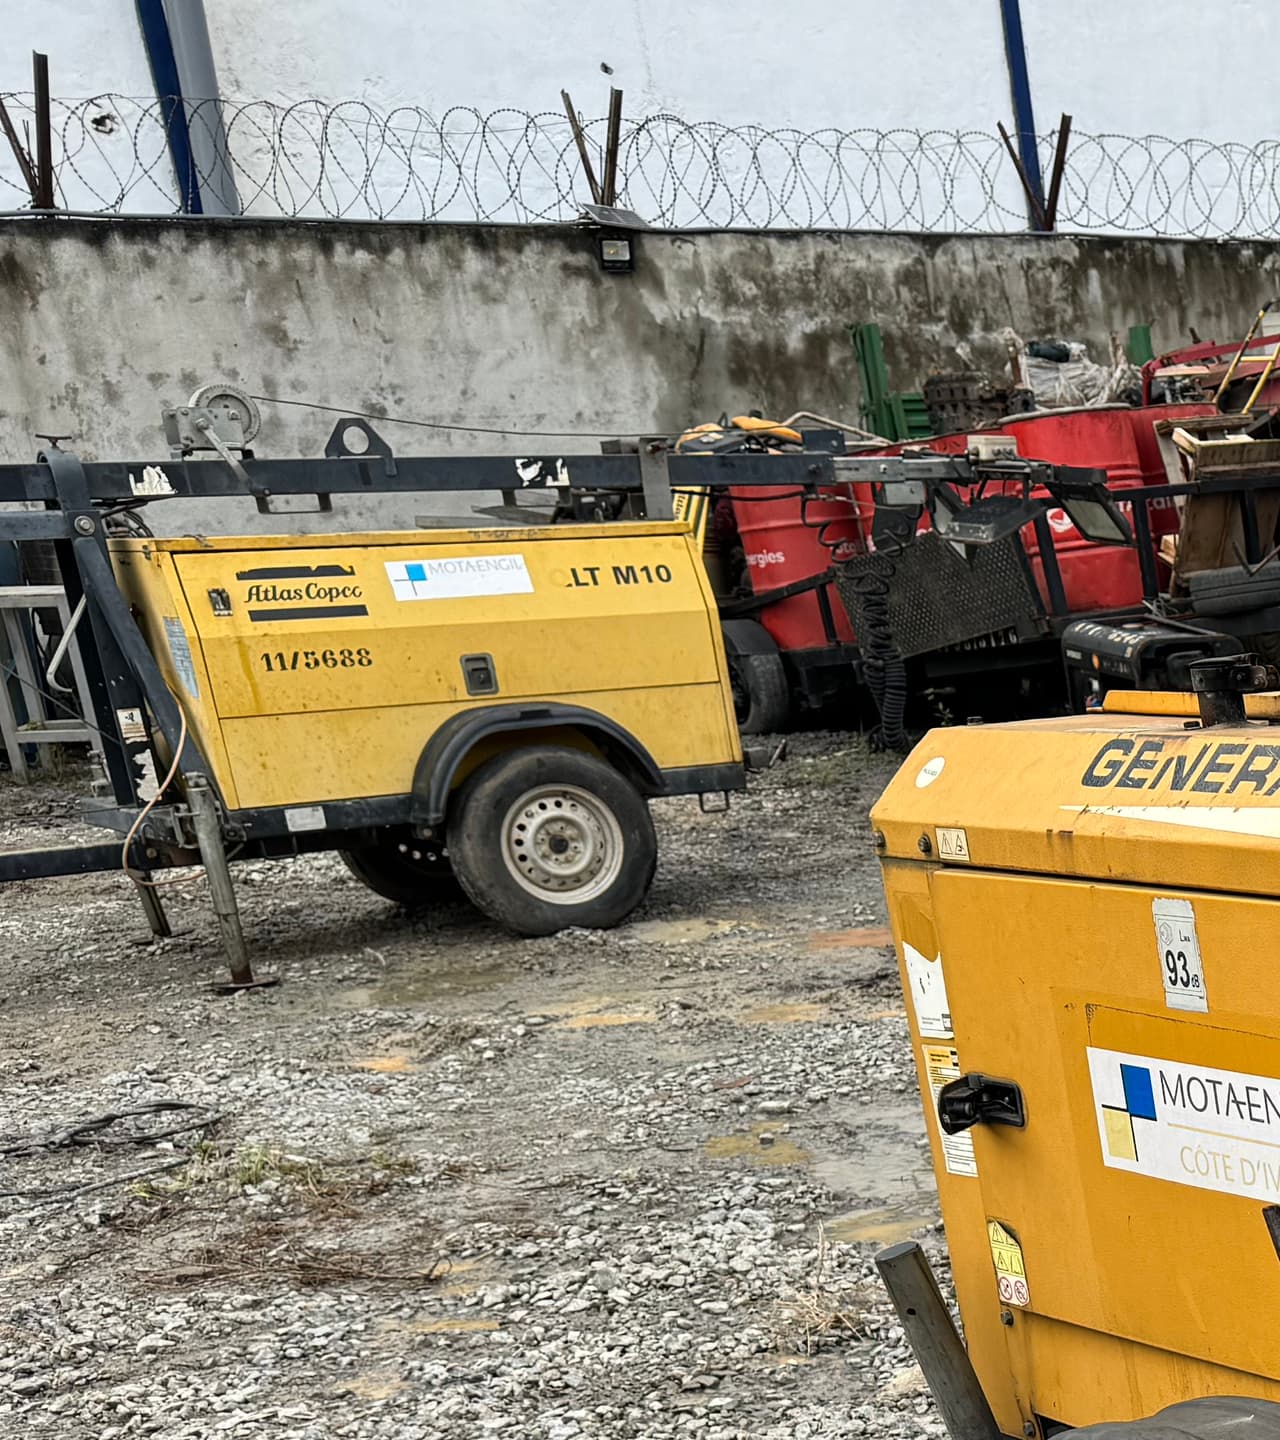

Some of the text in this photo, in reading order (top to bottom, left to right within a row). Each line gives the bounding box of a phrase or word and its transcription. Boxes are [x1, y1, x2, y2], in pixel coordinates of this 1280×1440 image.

[613, 563, 673, 586] M10
[243, 584, 303, 604] Atlas
[259, 647, 374, 672] 11/5688
[1165, 949, 1191, 988] 93
[1179, 1142, 1236, 1183] CÔTE
